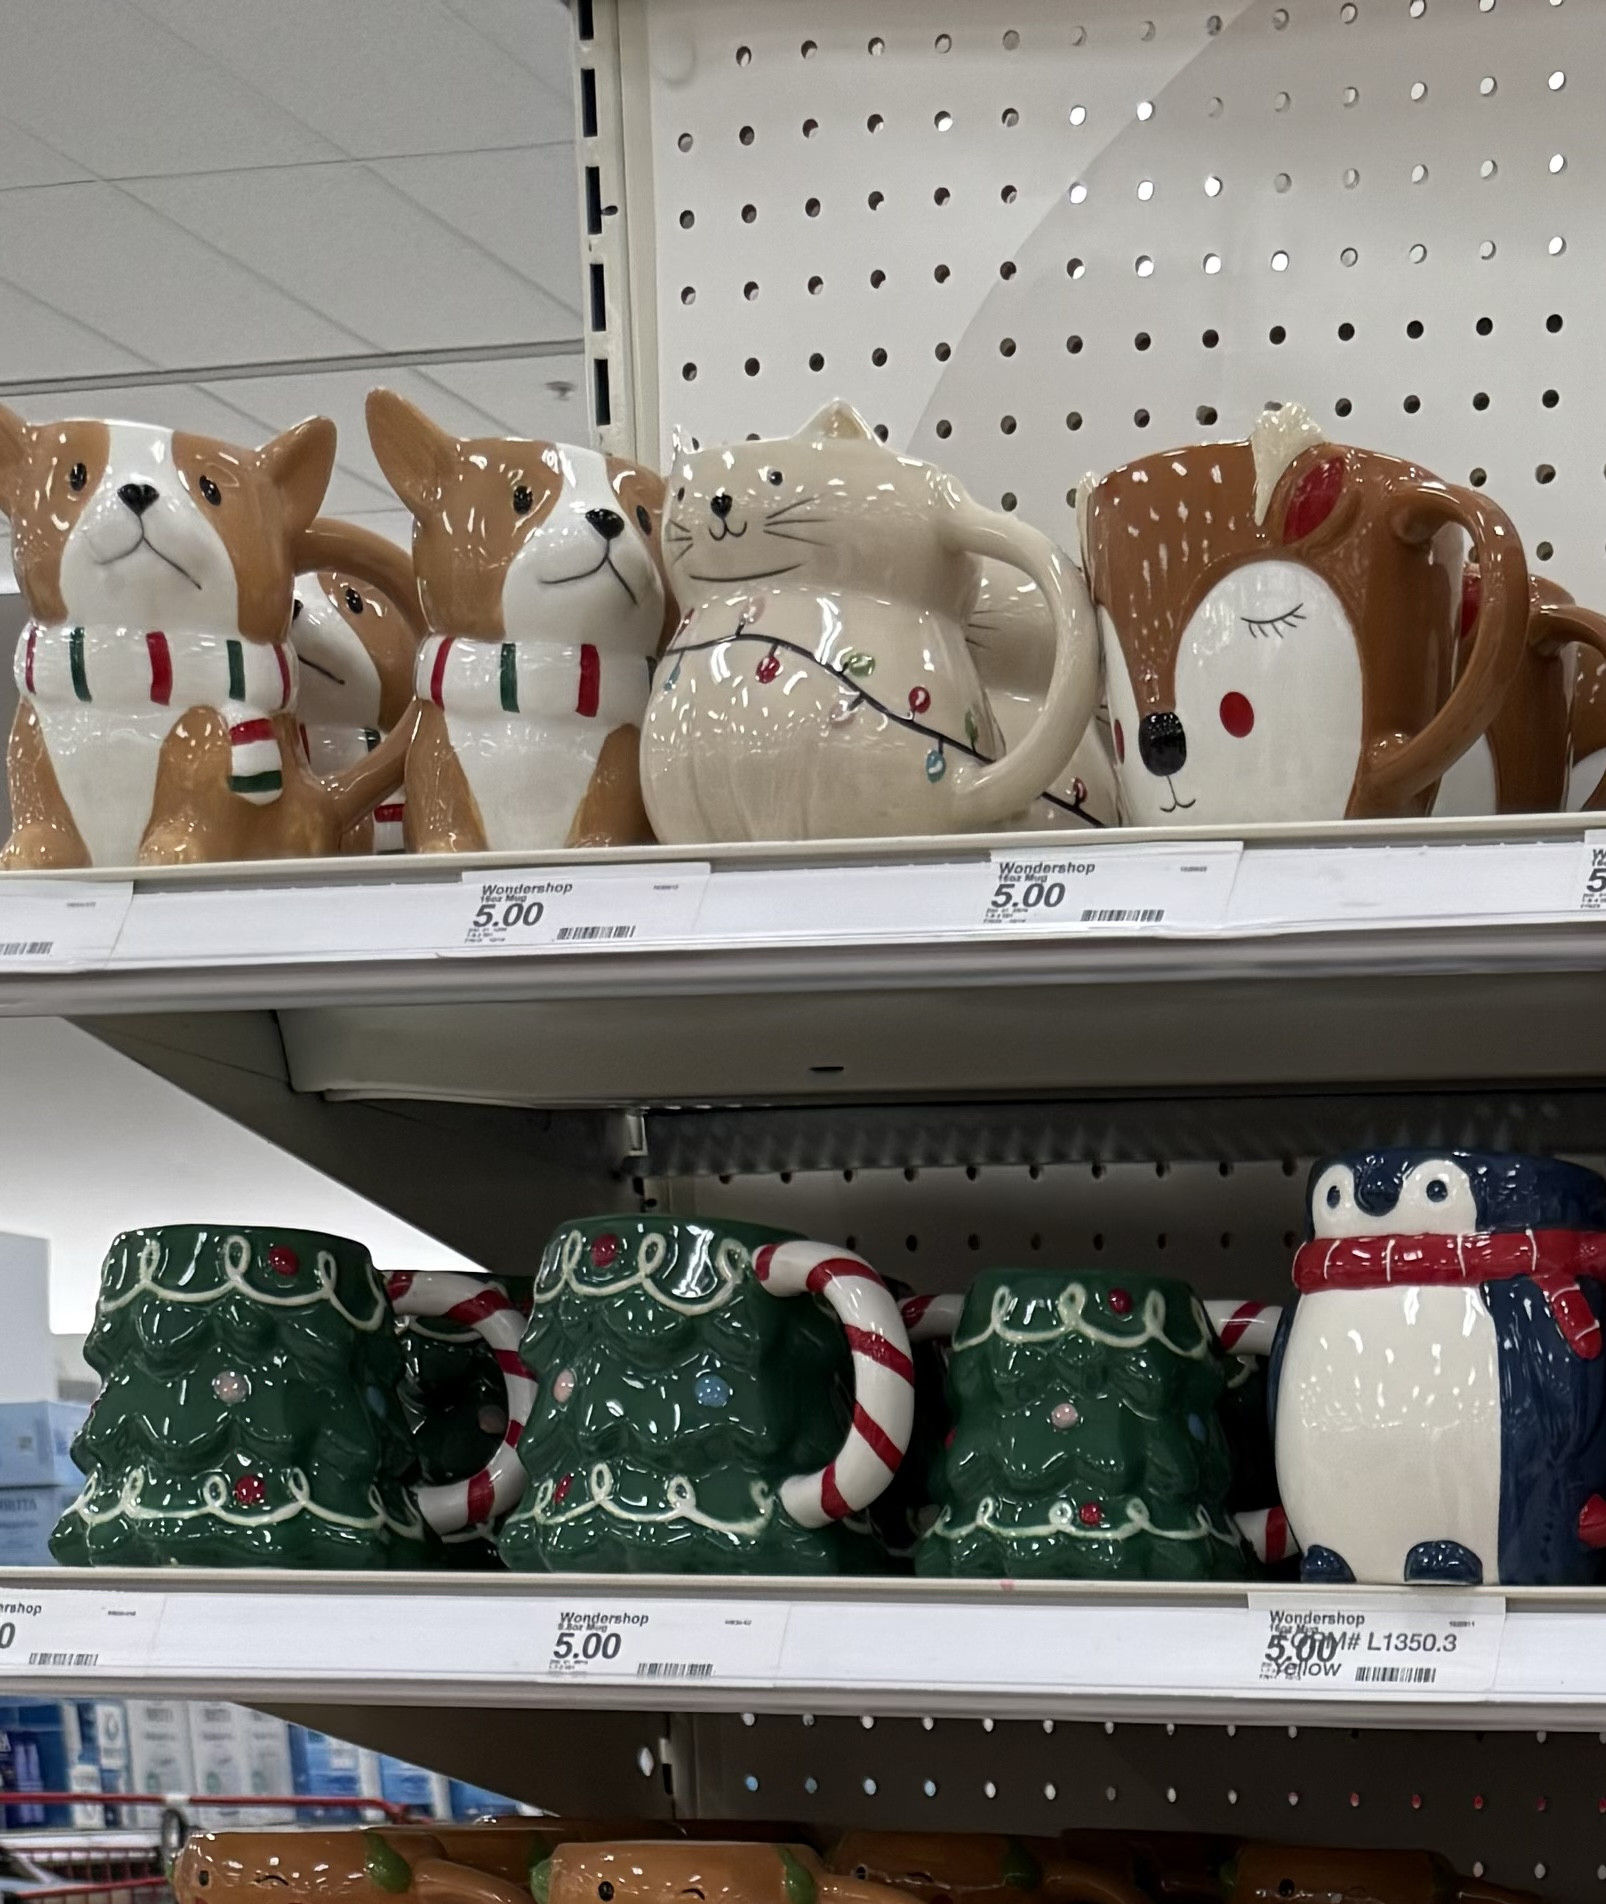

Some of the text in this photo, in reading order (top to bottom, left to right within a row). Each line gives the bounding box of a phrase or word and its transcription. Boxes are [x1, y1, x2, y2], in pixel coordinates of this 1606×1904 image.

[1000, 862, 1095, 875] Wondershop
[482, 883, 573, 896] Wondershop
[991, 883, 1065, 907] 5.00
[473, 902, 544, 927] 5.00
[560, 1612, 649, 1626] Wondershop
[1269, 1611, 1364, 1627] Wondershop
[553, 1632, 621, 1659] 5.00
[1367, 1631, 1457, 1652] L1350.3
